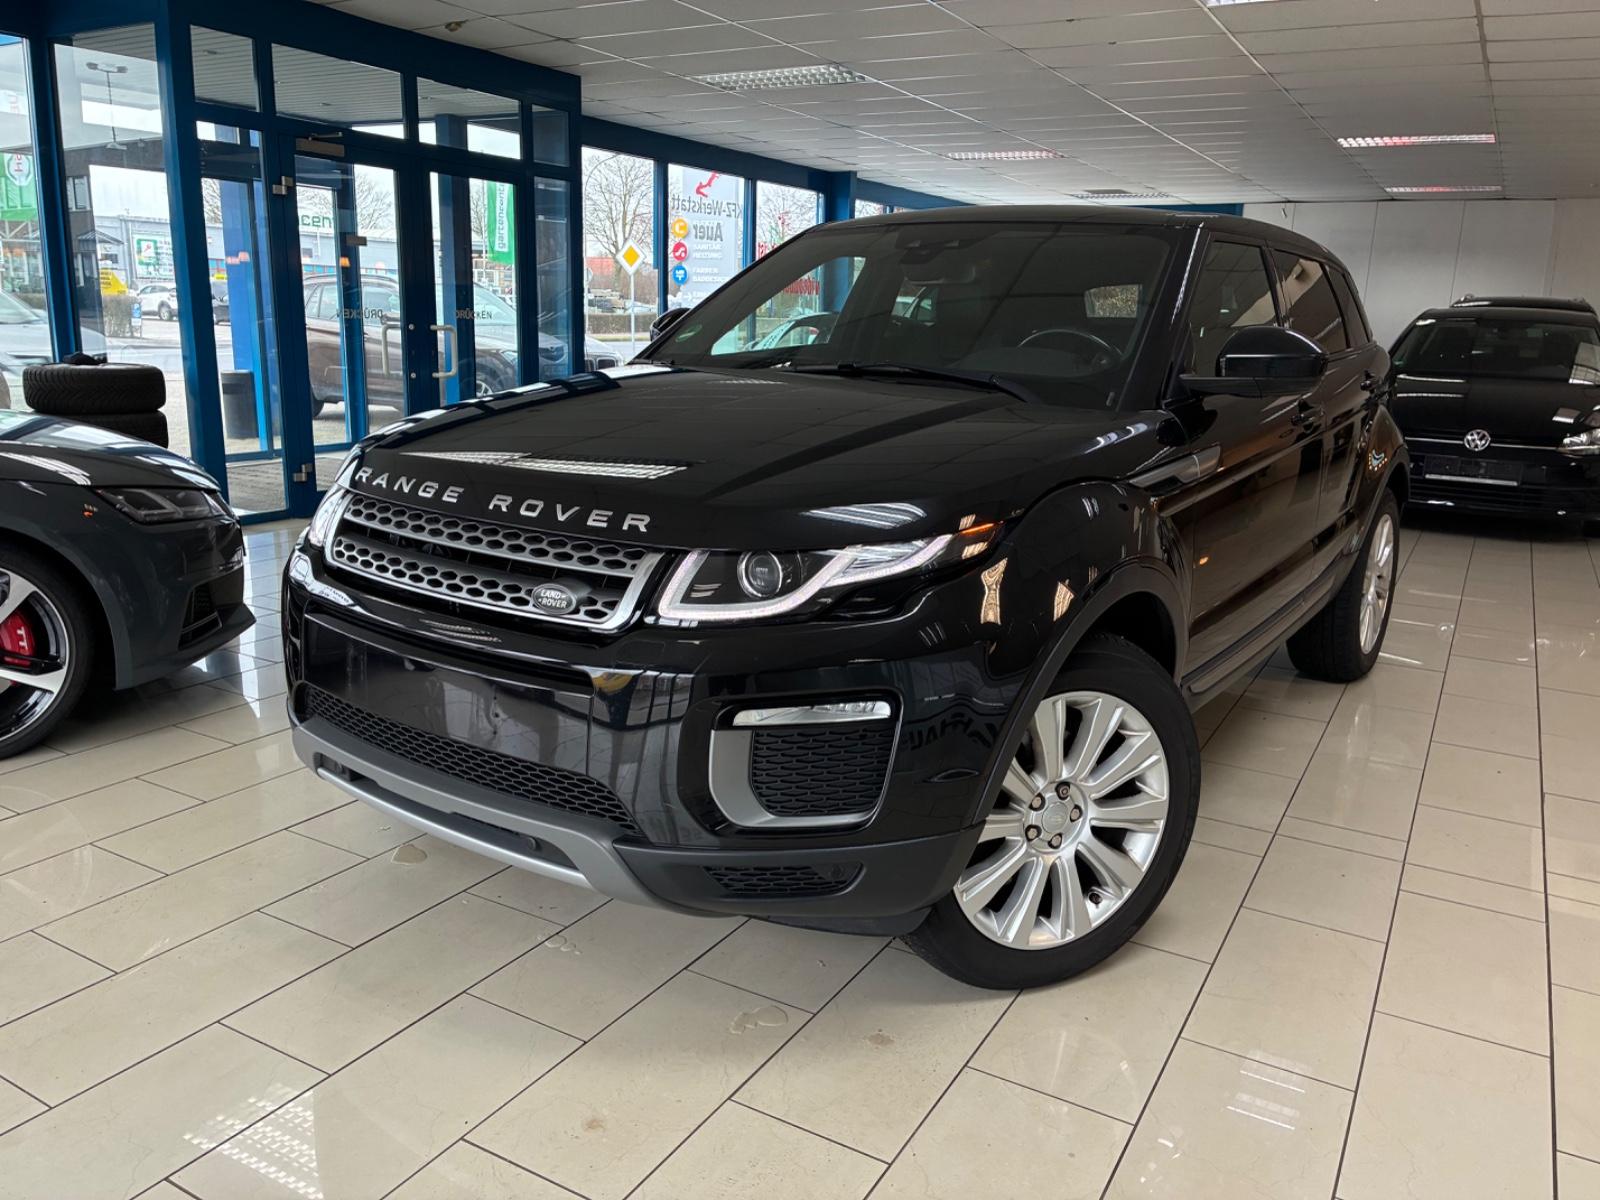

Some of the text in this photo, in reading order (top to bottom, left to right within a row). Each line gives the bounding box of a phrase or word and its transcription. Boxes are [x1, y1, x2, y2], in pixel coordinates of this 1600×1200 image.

[300, 214, 334, 228] cen
[455, 307, 492, 320] DRÜCKEN
[354, 466, 652, 533] RANGE ROVER
[540, 589, 561, 600] LAND
[541, 597, 568, 609] ROVER
[16, 626, 28, 650] TT
